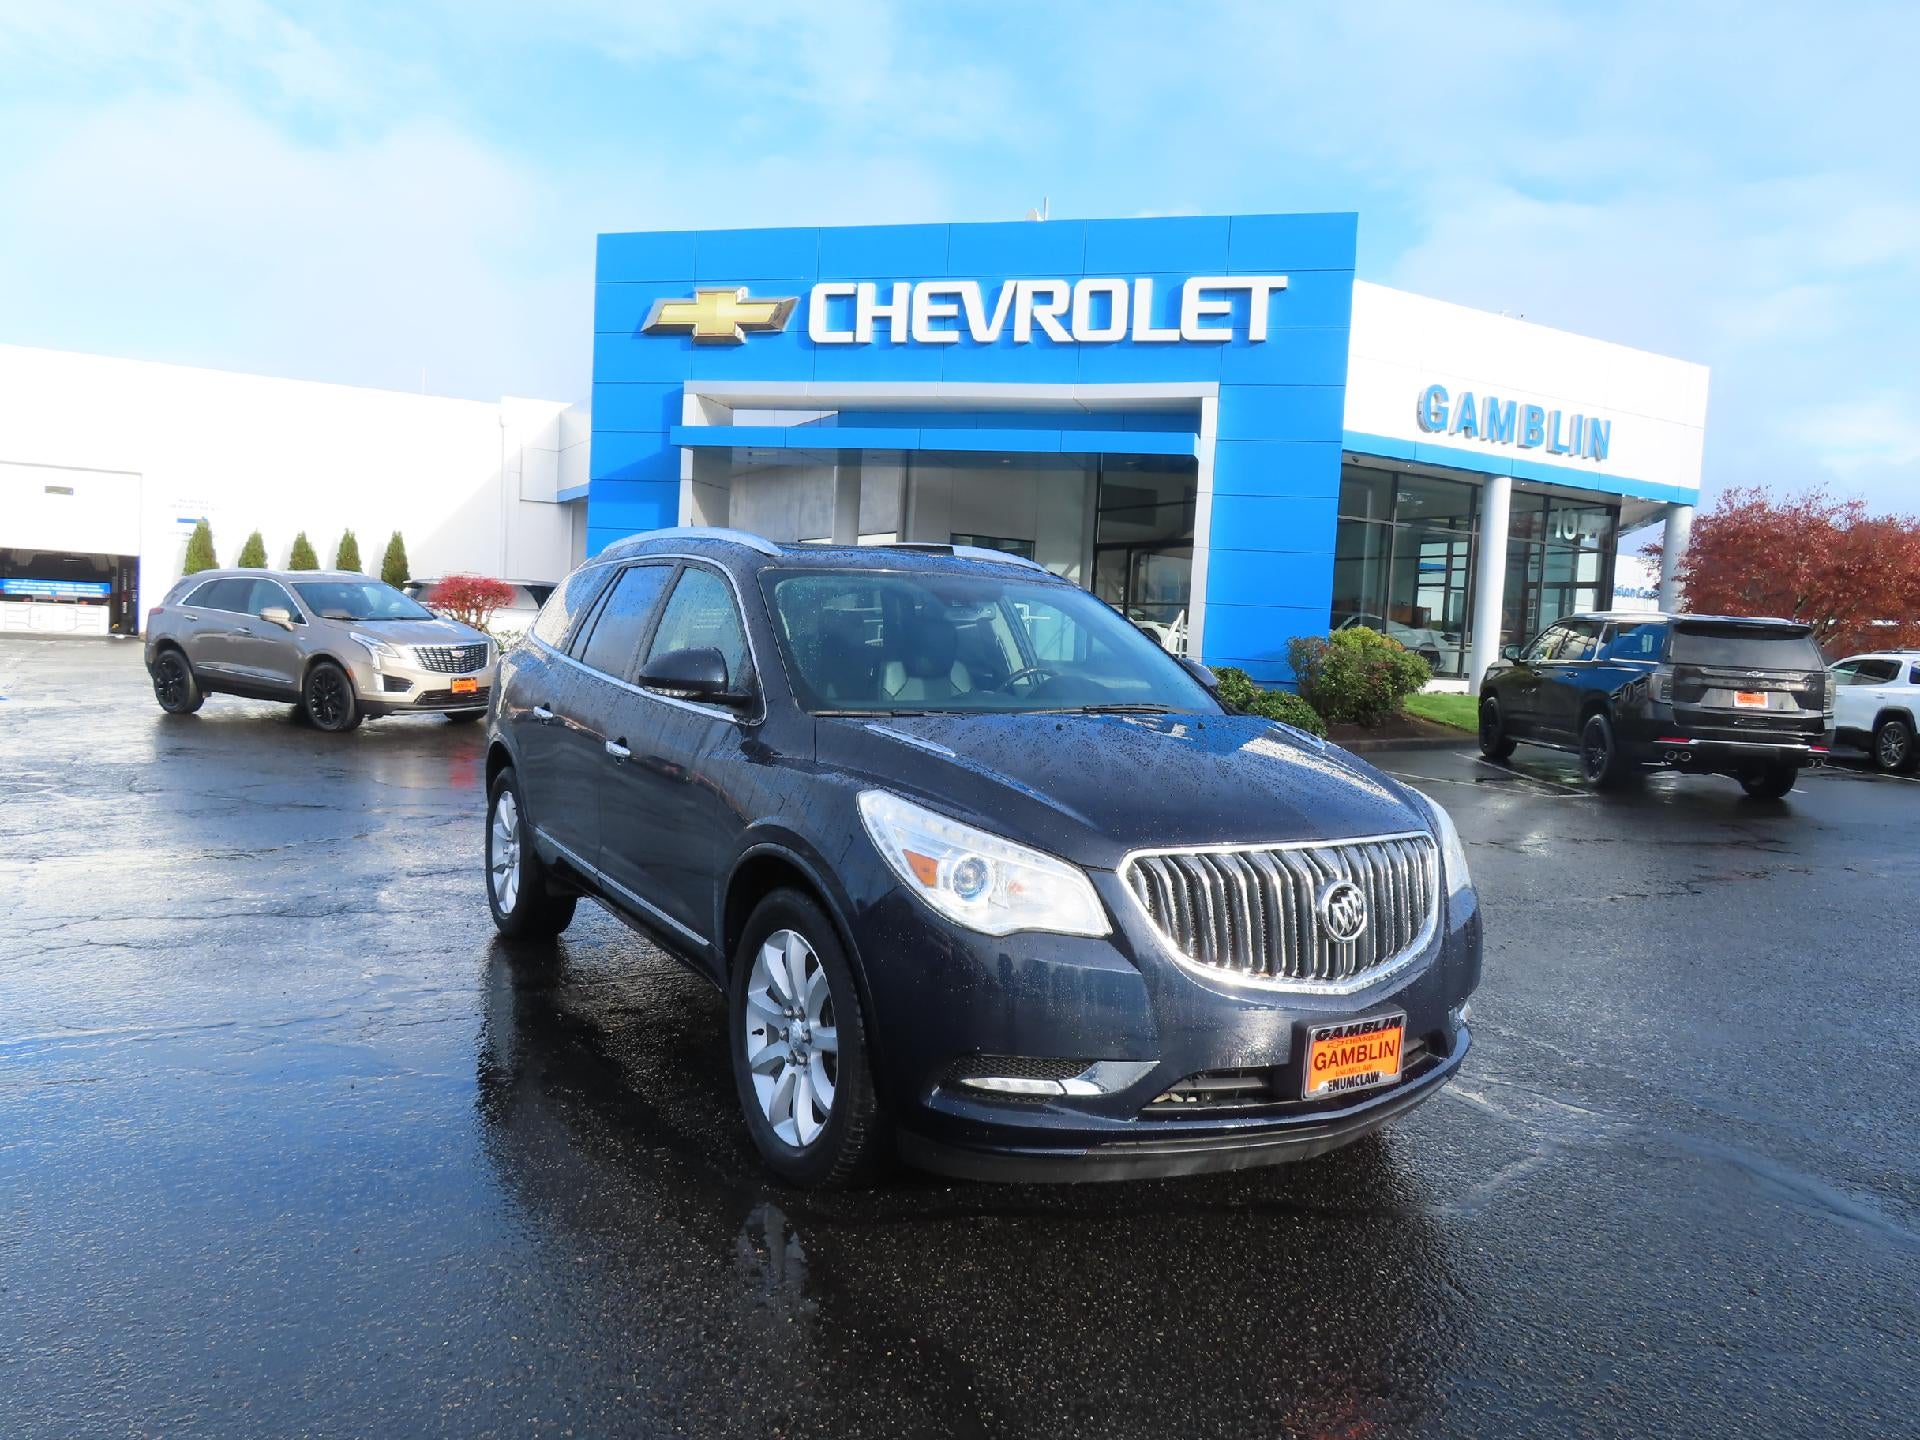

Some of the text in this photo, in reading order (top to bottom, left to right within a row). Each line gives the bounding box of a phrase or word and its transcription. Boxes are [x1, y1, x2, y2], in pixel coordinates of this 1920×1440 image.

[808, 275, 1288, 344] CHEVROLET
[1417, 384, 1611, 462] GAMBLIN
[1315, 1016, 1402, 1041] GAMBLIN
[1313, 1039, 1395, 1071] GAMBLIN
[1328, 1071, 1380, 1092] ENUMCLAW
